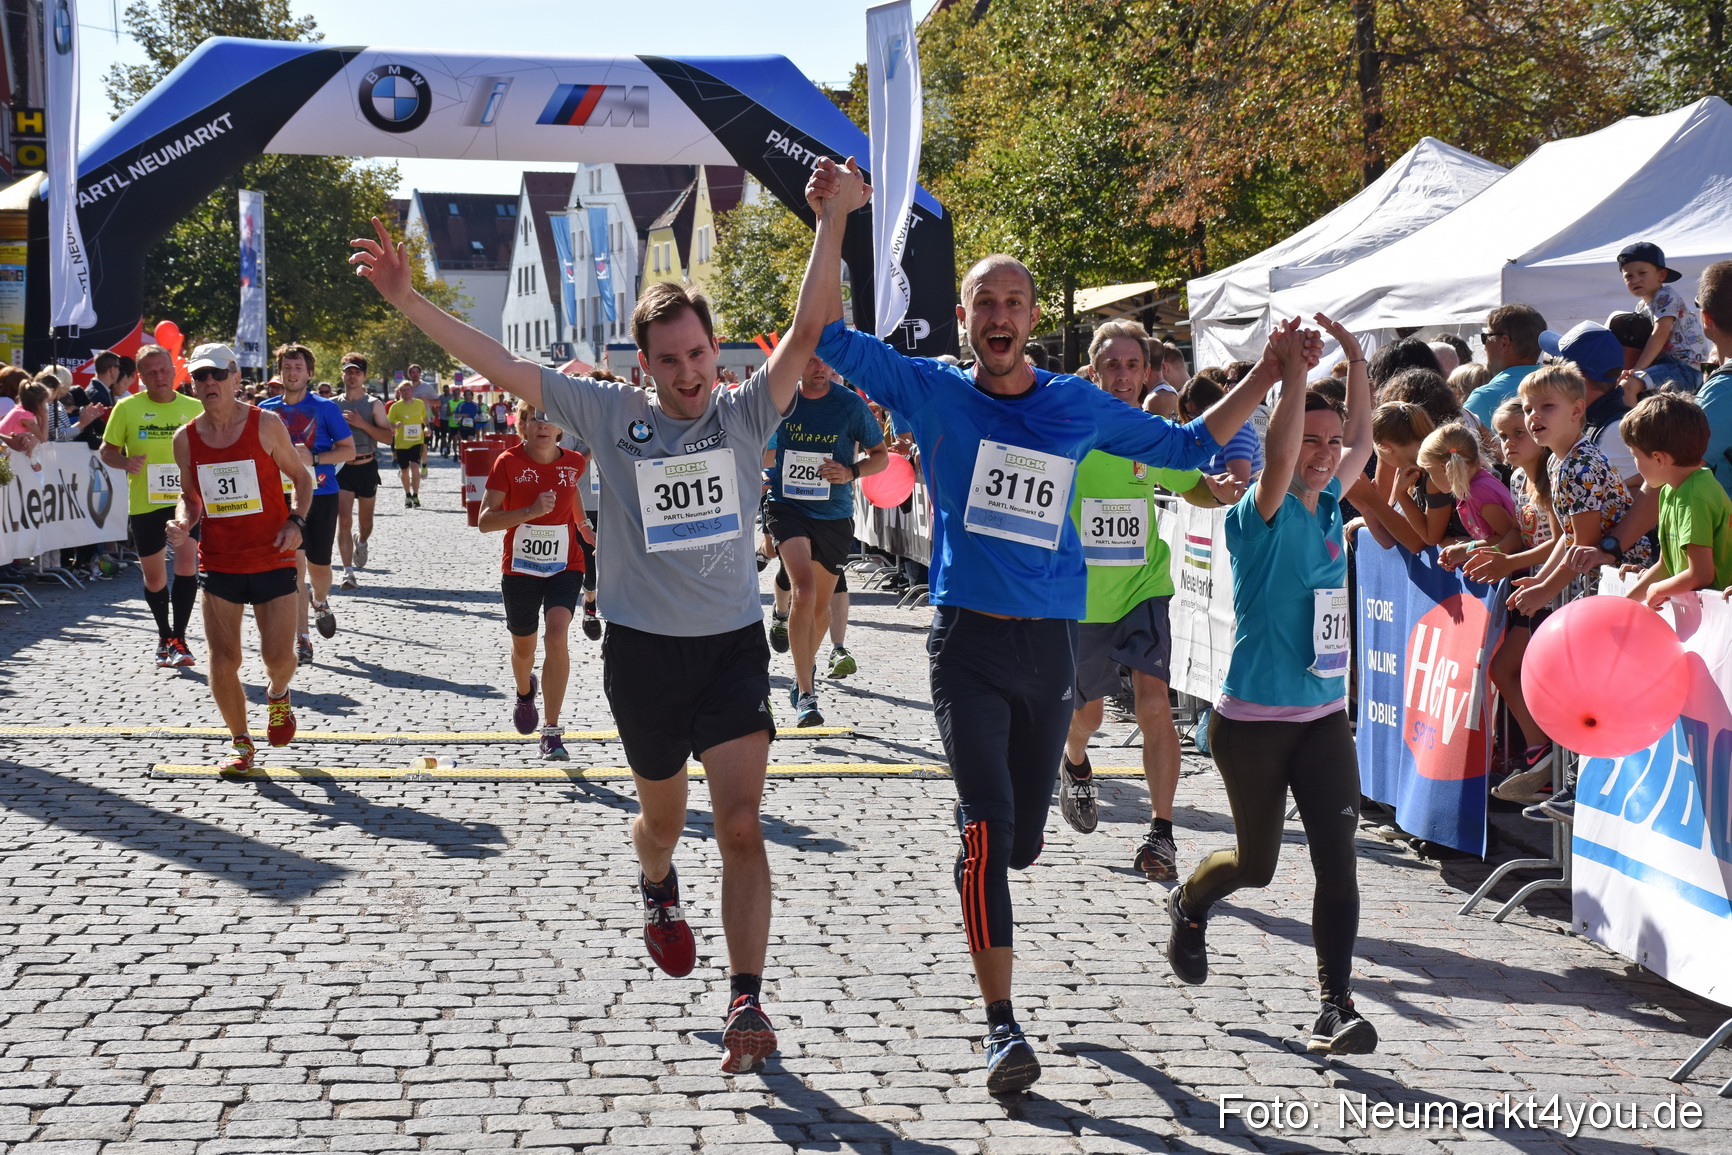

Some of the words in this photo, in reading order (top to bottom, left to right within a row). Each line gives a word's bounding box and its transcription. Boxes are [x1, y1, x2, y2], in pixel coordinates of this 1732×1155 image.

[367, 64, 425, 89] BMW
[127, 112, 233, 180] NEUMARKT
[617, 438, 642, 458] PARTL
[213, 467, 239, 475] BOCK
[665, 460, 708, 475] BOCK
[1005, 453, 1047, 471] BOCK
[218, 478, 237, 495] 31
[654, 475, 723, 511] 3015
[796, 487, 814, 496] Bernd
[985, 468, 1055, 508] 3116
[216, 502, 248, 512] Bernhard
[685, 509, 714, 518] Neumarkt
[988, 500, 1008, 509] PARTL
[1009, 505, 1037, 516] Neumarkt
[531, 529, 556, 537] BOCK
[672, 517, 722, 537] CHRIS
[1091, 516, 1140, 537] 3108
[521, 539, 560, 556] 3001
[1366, 598, 1393, 622] STORE
[1322, 613, 1349, 641] 311
[1368, 649, 1397, 676] ONLINE
[1412, 720, 1436, 750] SPTS
